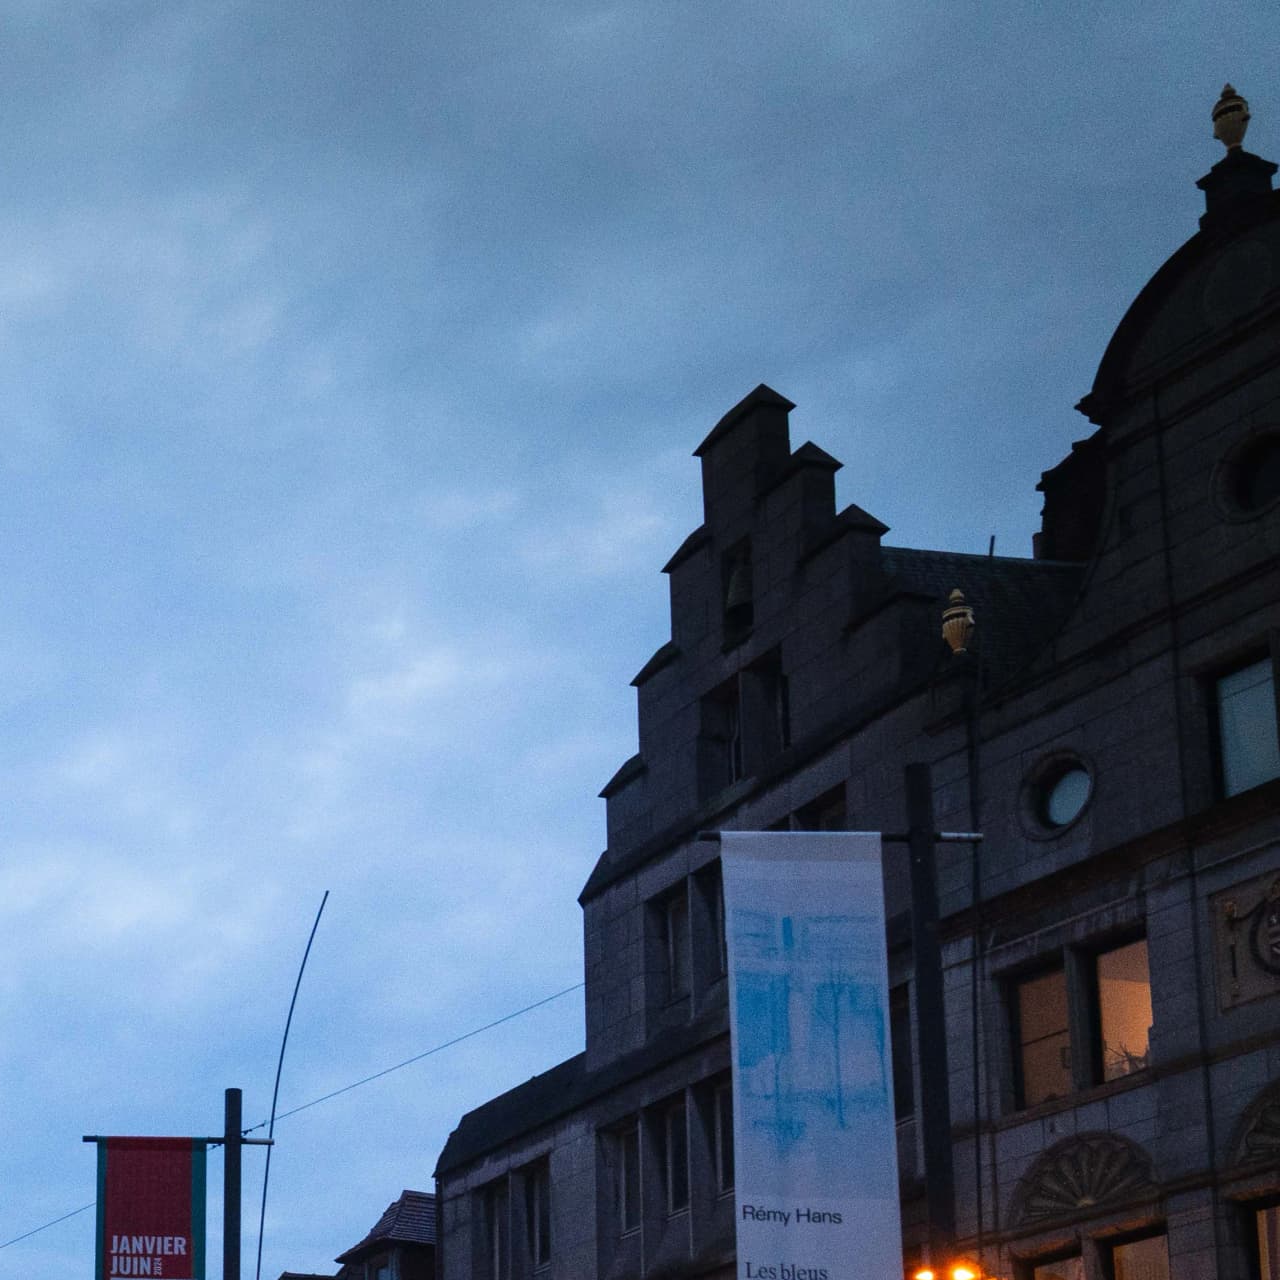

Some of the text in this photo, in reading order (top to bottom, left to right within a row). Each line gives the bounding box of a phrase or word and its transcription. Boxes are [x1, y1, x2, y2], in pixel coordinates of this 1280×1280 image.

[742, 1204, 843, 1227] Rémy Hans
[110, 1234, 187, 1256] JANVIER
[110, 1255, 152, 1276] JUIN
[745, 1261, 777, 1280] Les
